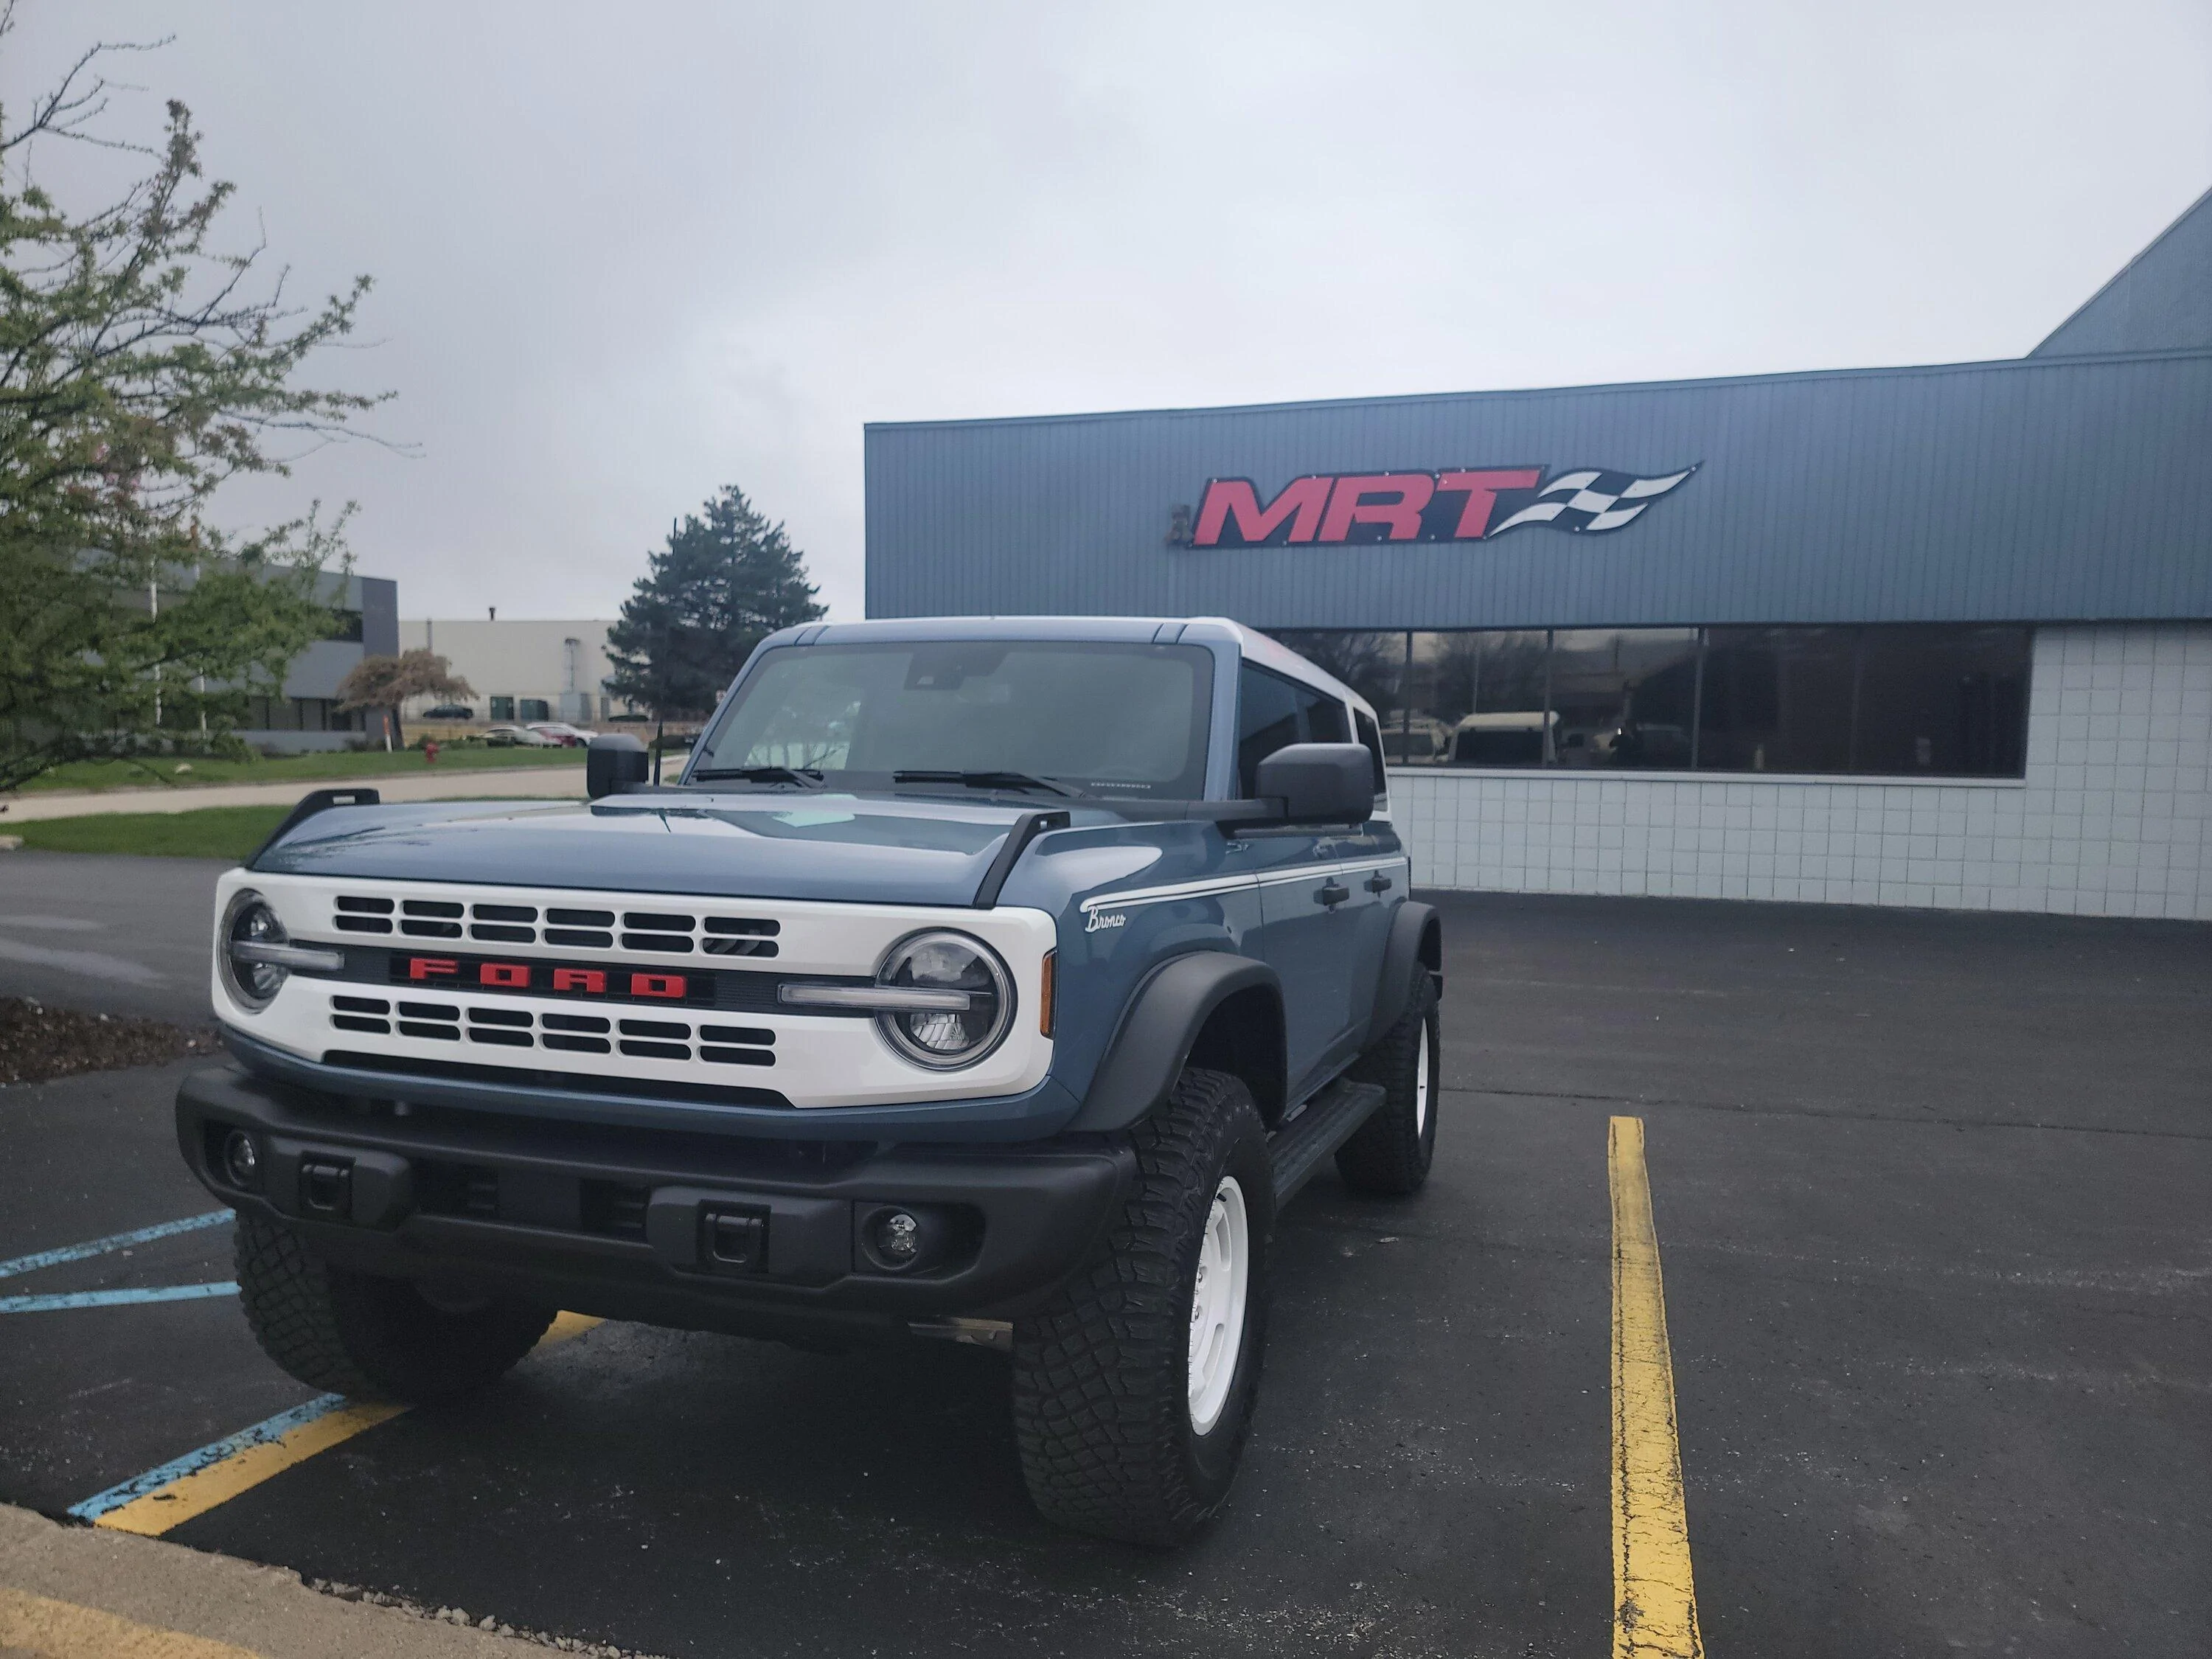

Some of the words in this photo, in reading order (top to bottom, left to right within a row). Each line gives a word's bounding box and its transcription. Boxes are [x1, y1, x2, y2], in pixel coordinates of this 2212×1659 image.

[1192, 469, 1541, 546] MRT
[1085, 905, 1126, 933] Bronco
[409, 958, 686, 998] FORD
